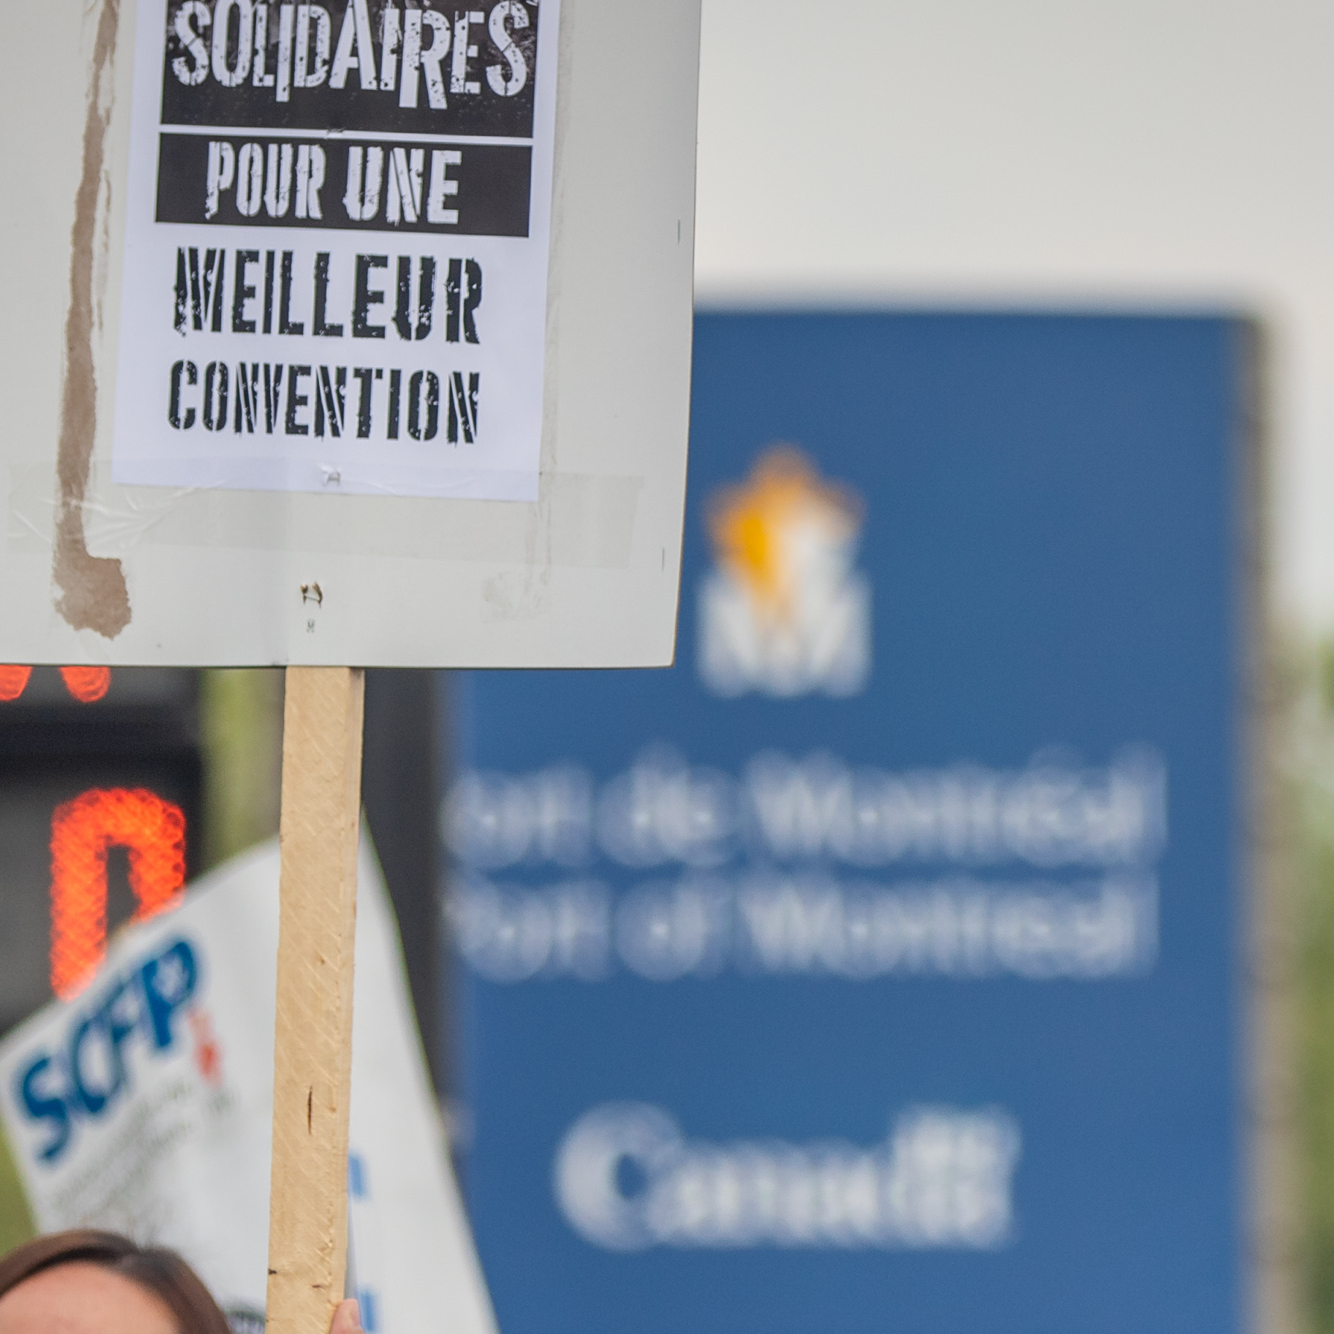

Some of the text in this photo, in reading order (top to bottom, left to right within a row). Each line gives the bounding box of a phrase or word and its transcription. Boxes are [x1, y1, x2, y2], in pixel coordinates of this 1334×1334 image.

[172, 0, 531, 109] SOLIDAIRES
[205, 141, 462, 227] POUR UNE
[173, 246, 483, 345] MEILLEUR
[169, 360, 480, 446] CONVENTION
[15, 938, 199, 1166] SCFP
